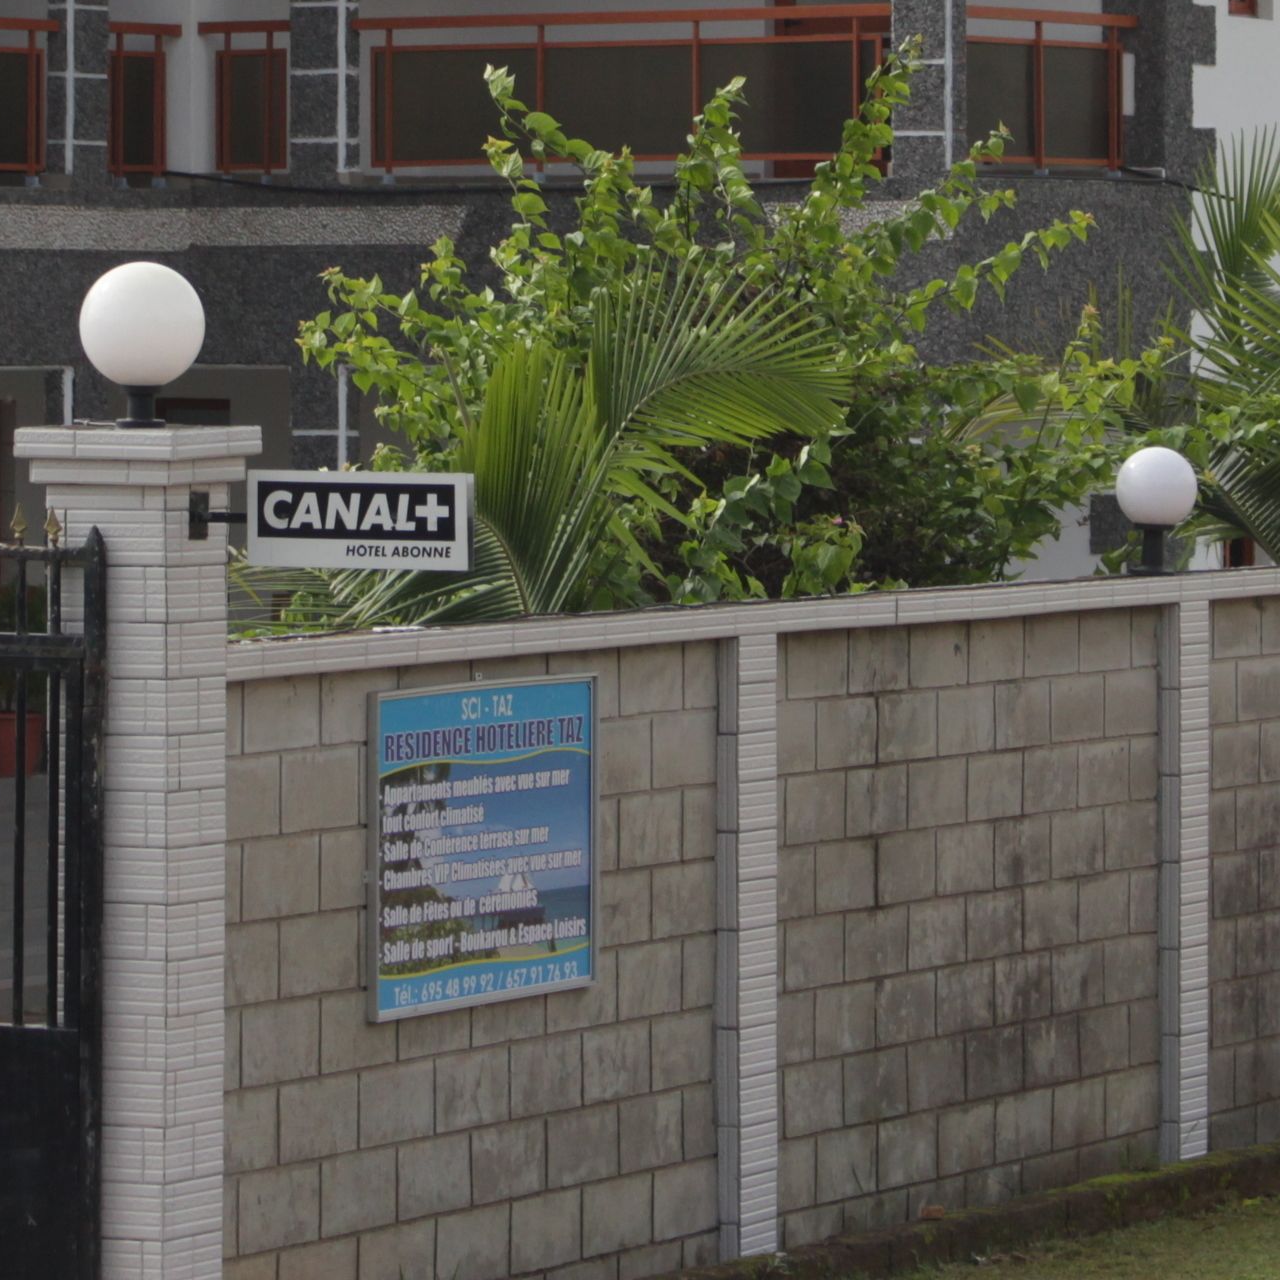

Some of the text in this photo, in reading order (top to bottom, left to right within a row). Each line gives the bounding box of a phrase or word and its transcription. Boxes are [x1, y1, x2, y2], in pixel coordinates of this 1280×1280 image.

[263, 490, 450, 532] CANAL+
[461, 696, 481, 720] SCI
[492, 694, 513, 717] TAZ
[383, 715, 584, 763] RESIDENCE HOTELIERE TAZ
[384, 780, 452, 806] Appartements
[453, 774, 493, 798] meublés
[495, 775, 517, 793] avec
[518, 774, 534, 790] vue
[536, 772, 551, 787] sur
[552, 769, 570, 785] mer
[383, 802, 484, 833] tout confort climatisé
[384, 839, 409, 862] Salle
[410, 837, 422, 858] de
[515, 828, 530, 845] sur
[531, 826, 549, 843] mer
[384, 867, 432, 891] Chambres
[434, 863, 450, 884] VIP
[507, 856, 529, 875] avec
[530, 853, 546, 871] vue
[547, 851, 563, 869] sur
[564, 848, 582, 867] mer
[384, 905, 410, 927] Salle
[411, 903, 422, 923] de
[463, 896, 476, 915] de
[384, 941, 410, 964] Salle
[411, 939, 425, 960] de
[426, 934, 453, 958] sport
[509, 929, 516, 944] &
[518, 922, 553, 944] Espace
[554, 916, 586, 939] Loisirs
[421, 980, 442, 1003] 695
[445, 977, 459, 997] 48
[463, 975, 477, 995] 99
[480, 972, 494, 993] 92
[506, 967, 526, 988] 657
[530, 965, 543, 985] 91
[547, 963, 561, 982] 76
[564, 960, 578, 980] 93
